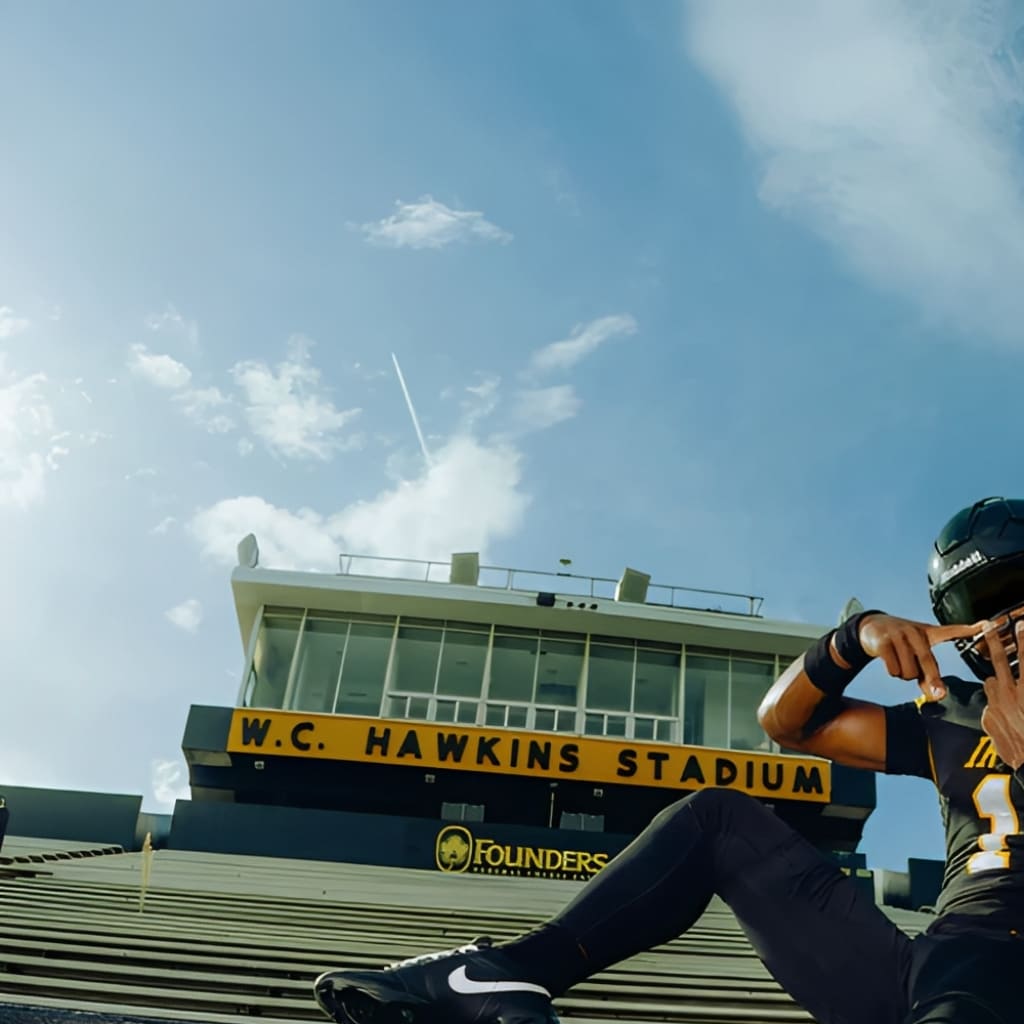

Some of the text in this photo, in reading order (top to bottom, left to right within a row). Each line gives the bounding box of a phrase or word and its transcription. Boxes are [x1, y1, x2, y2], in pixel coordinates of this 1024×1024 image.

[242, 717, 824, 795] W.C. HAWKINS STADIUM
[473, 838, 609, 875] FOUNDERS
[967, 773, 1020, 875] 1
